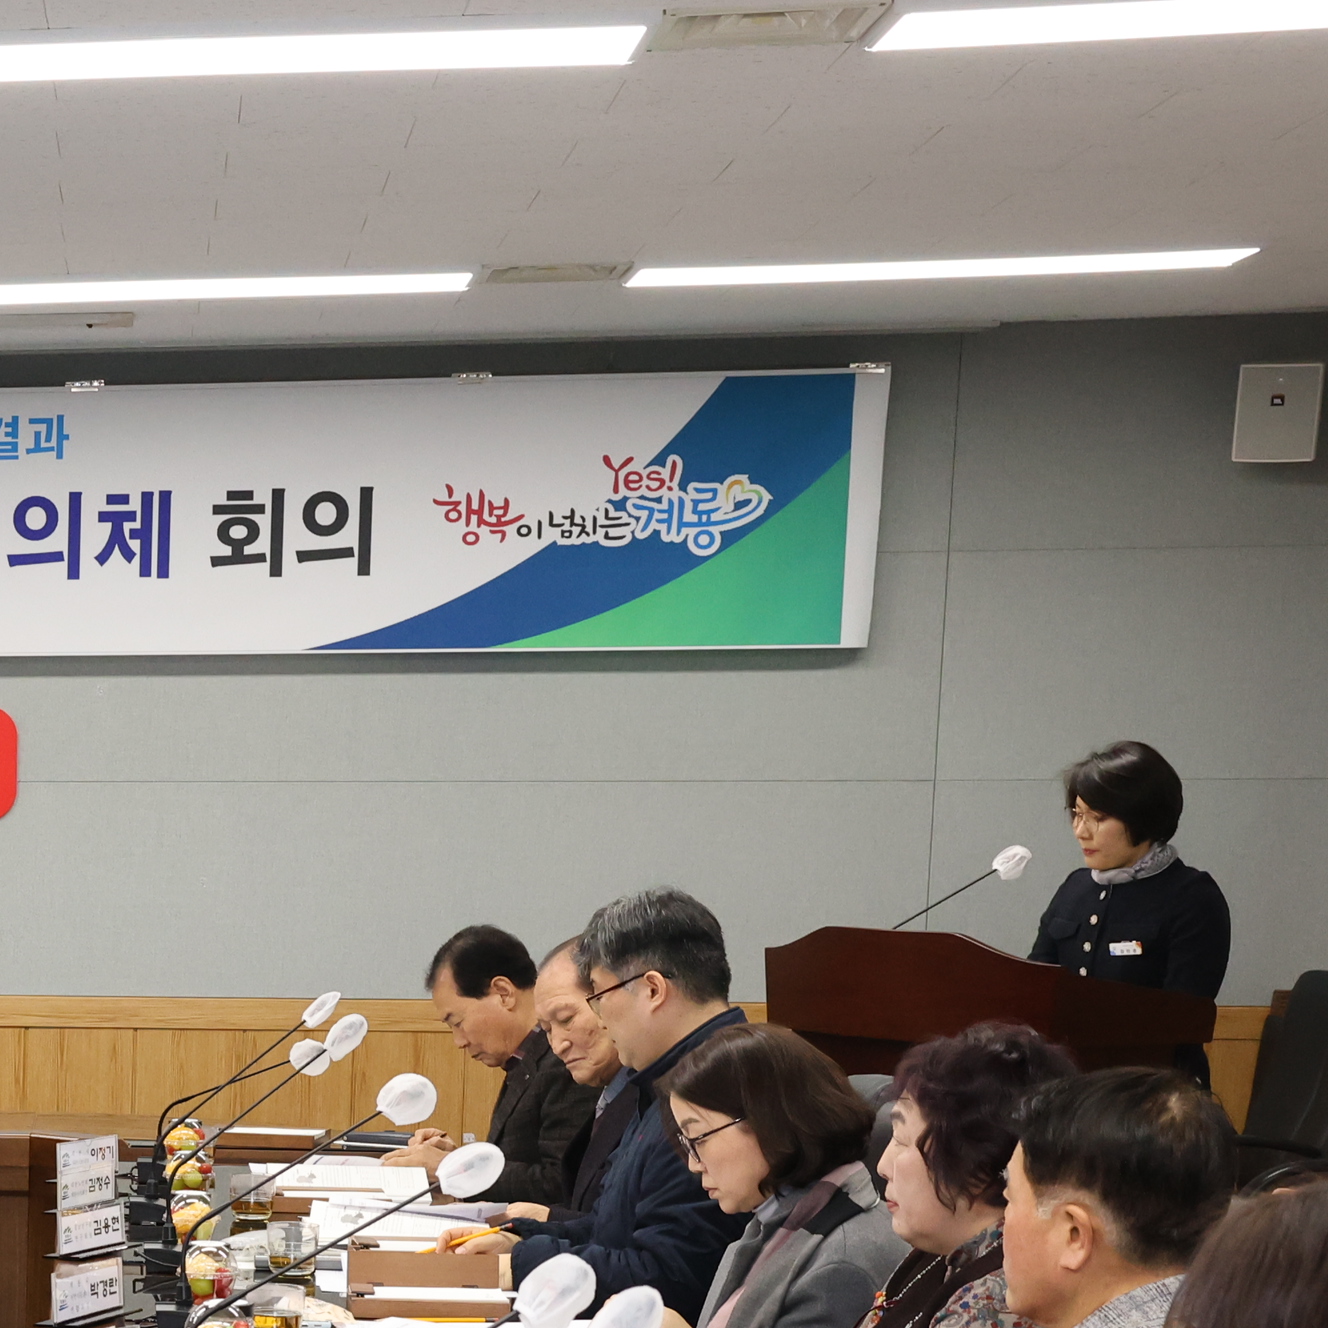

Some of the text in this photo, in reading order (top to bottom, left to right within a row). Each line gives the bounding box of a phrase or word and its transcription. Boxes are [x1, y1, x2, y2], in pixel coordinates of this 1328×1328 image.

[602, 453, 679, 496] Yes!
[210, 487, 374, 577] 회의
[90, 1145, 115, 1161] 이정기
[88, 1175, 112, 1194] 김정수
[90, 1276, 118, 1298] 박경란
